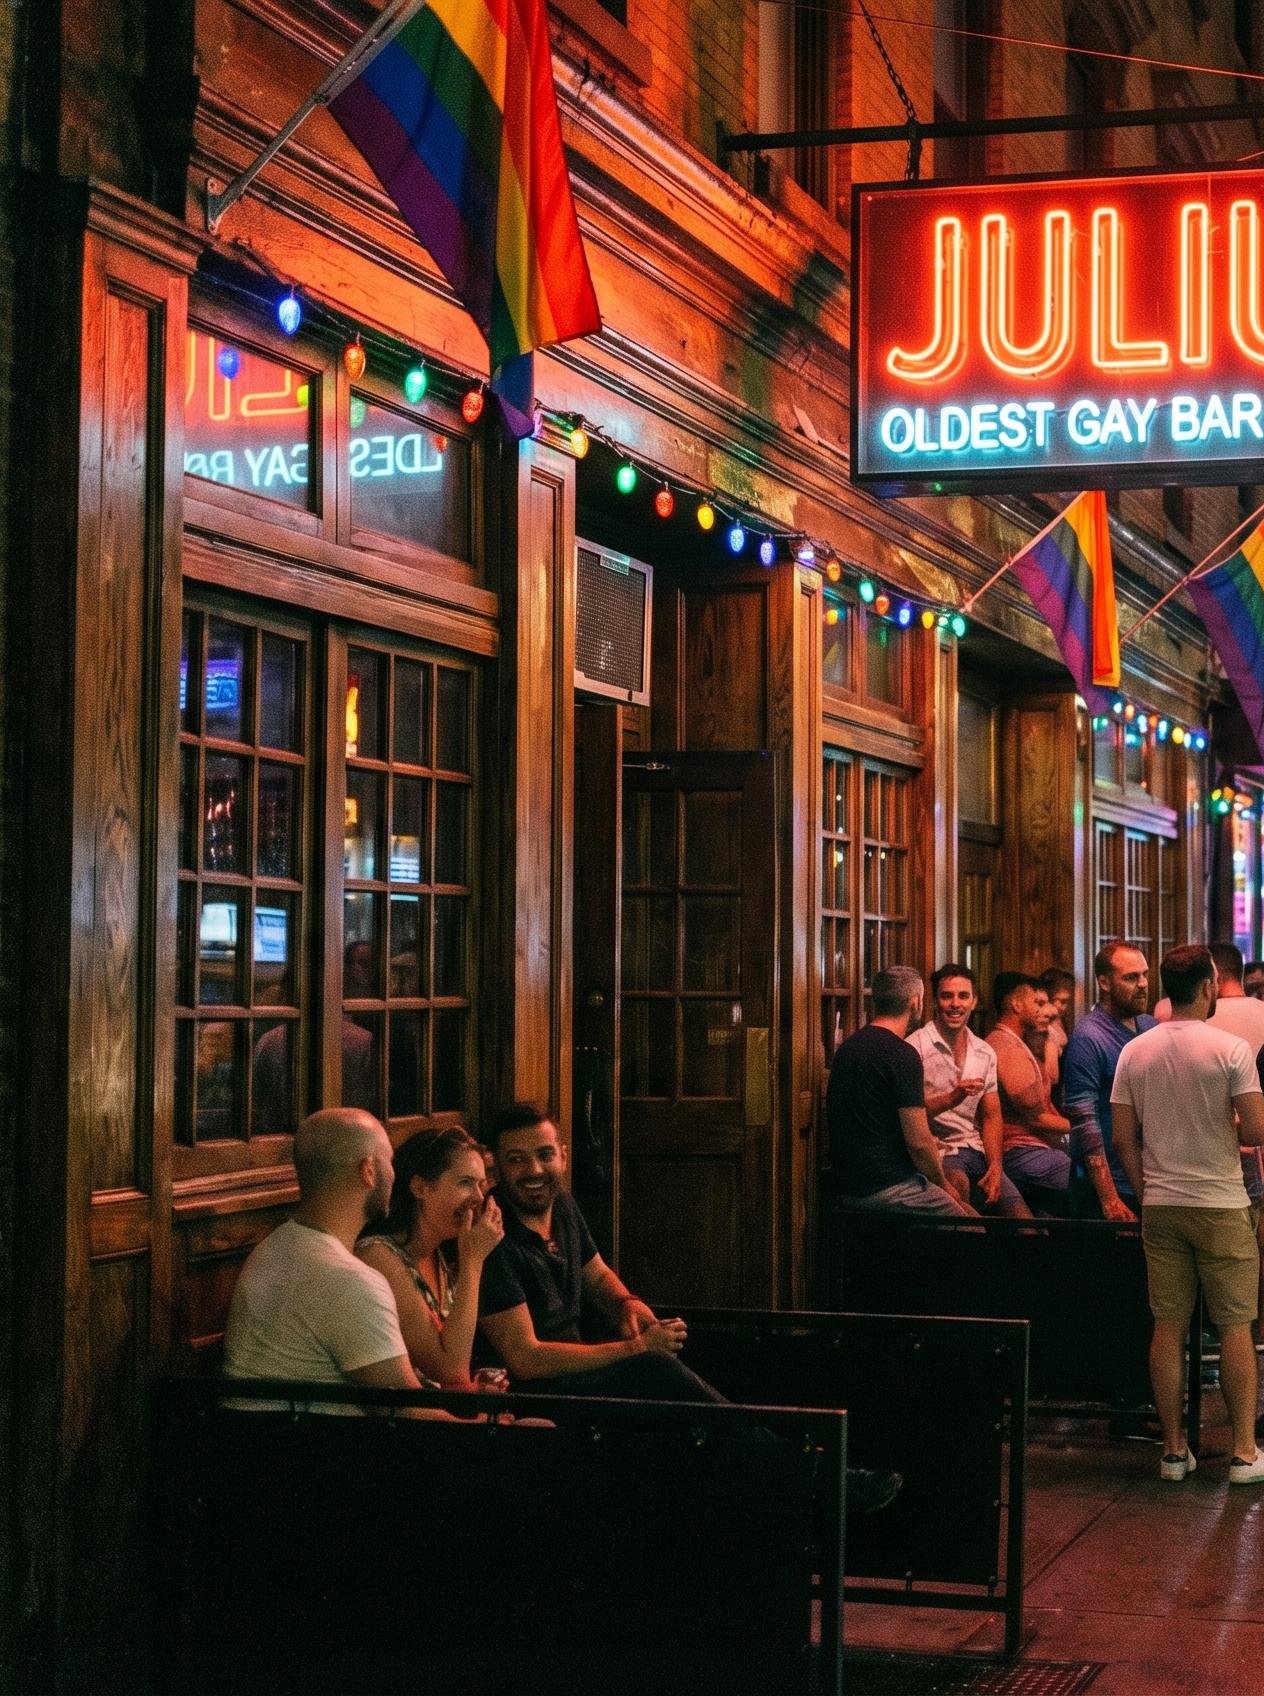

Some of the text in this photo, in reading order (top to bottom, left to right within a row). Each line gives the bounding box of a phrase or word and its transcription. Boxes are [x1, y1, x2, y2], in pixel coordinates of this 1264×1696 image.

[881, 402, 1056, 453] OLDEST
[1067, 397, 1158, 446] GAY
[1171, 392, 1264, 442] BAR
